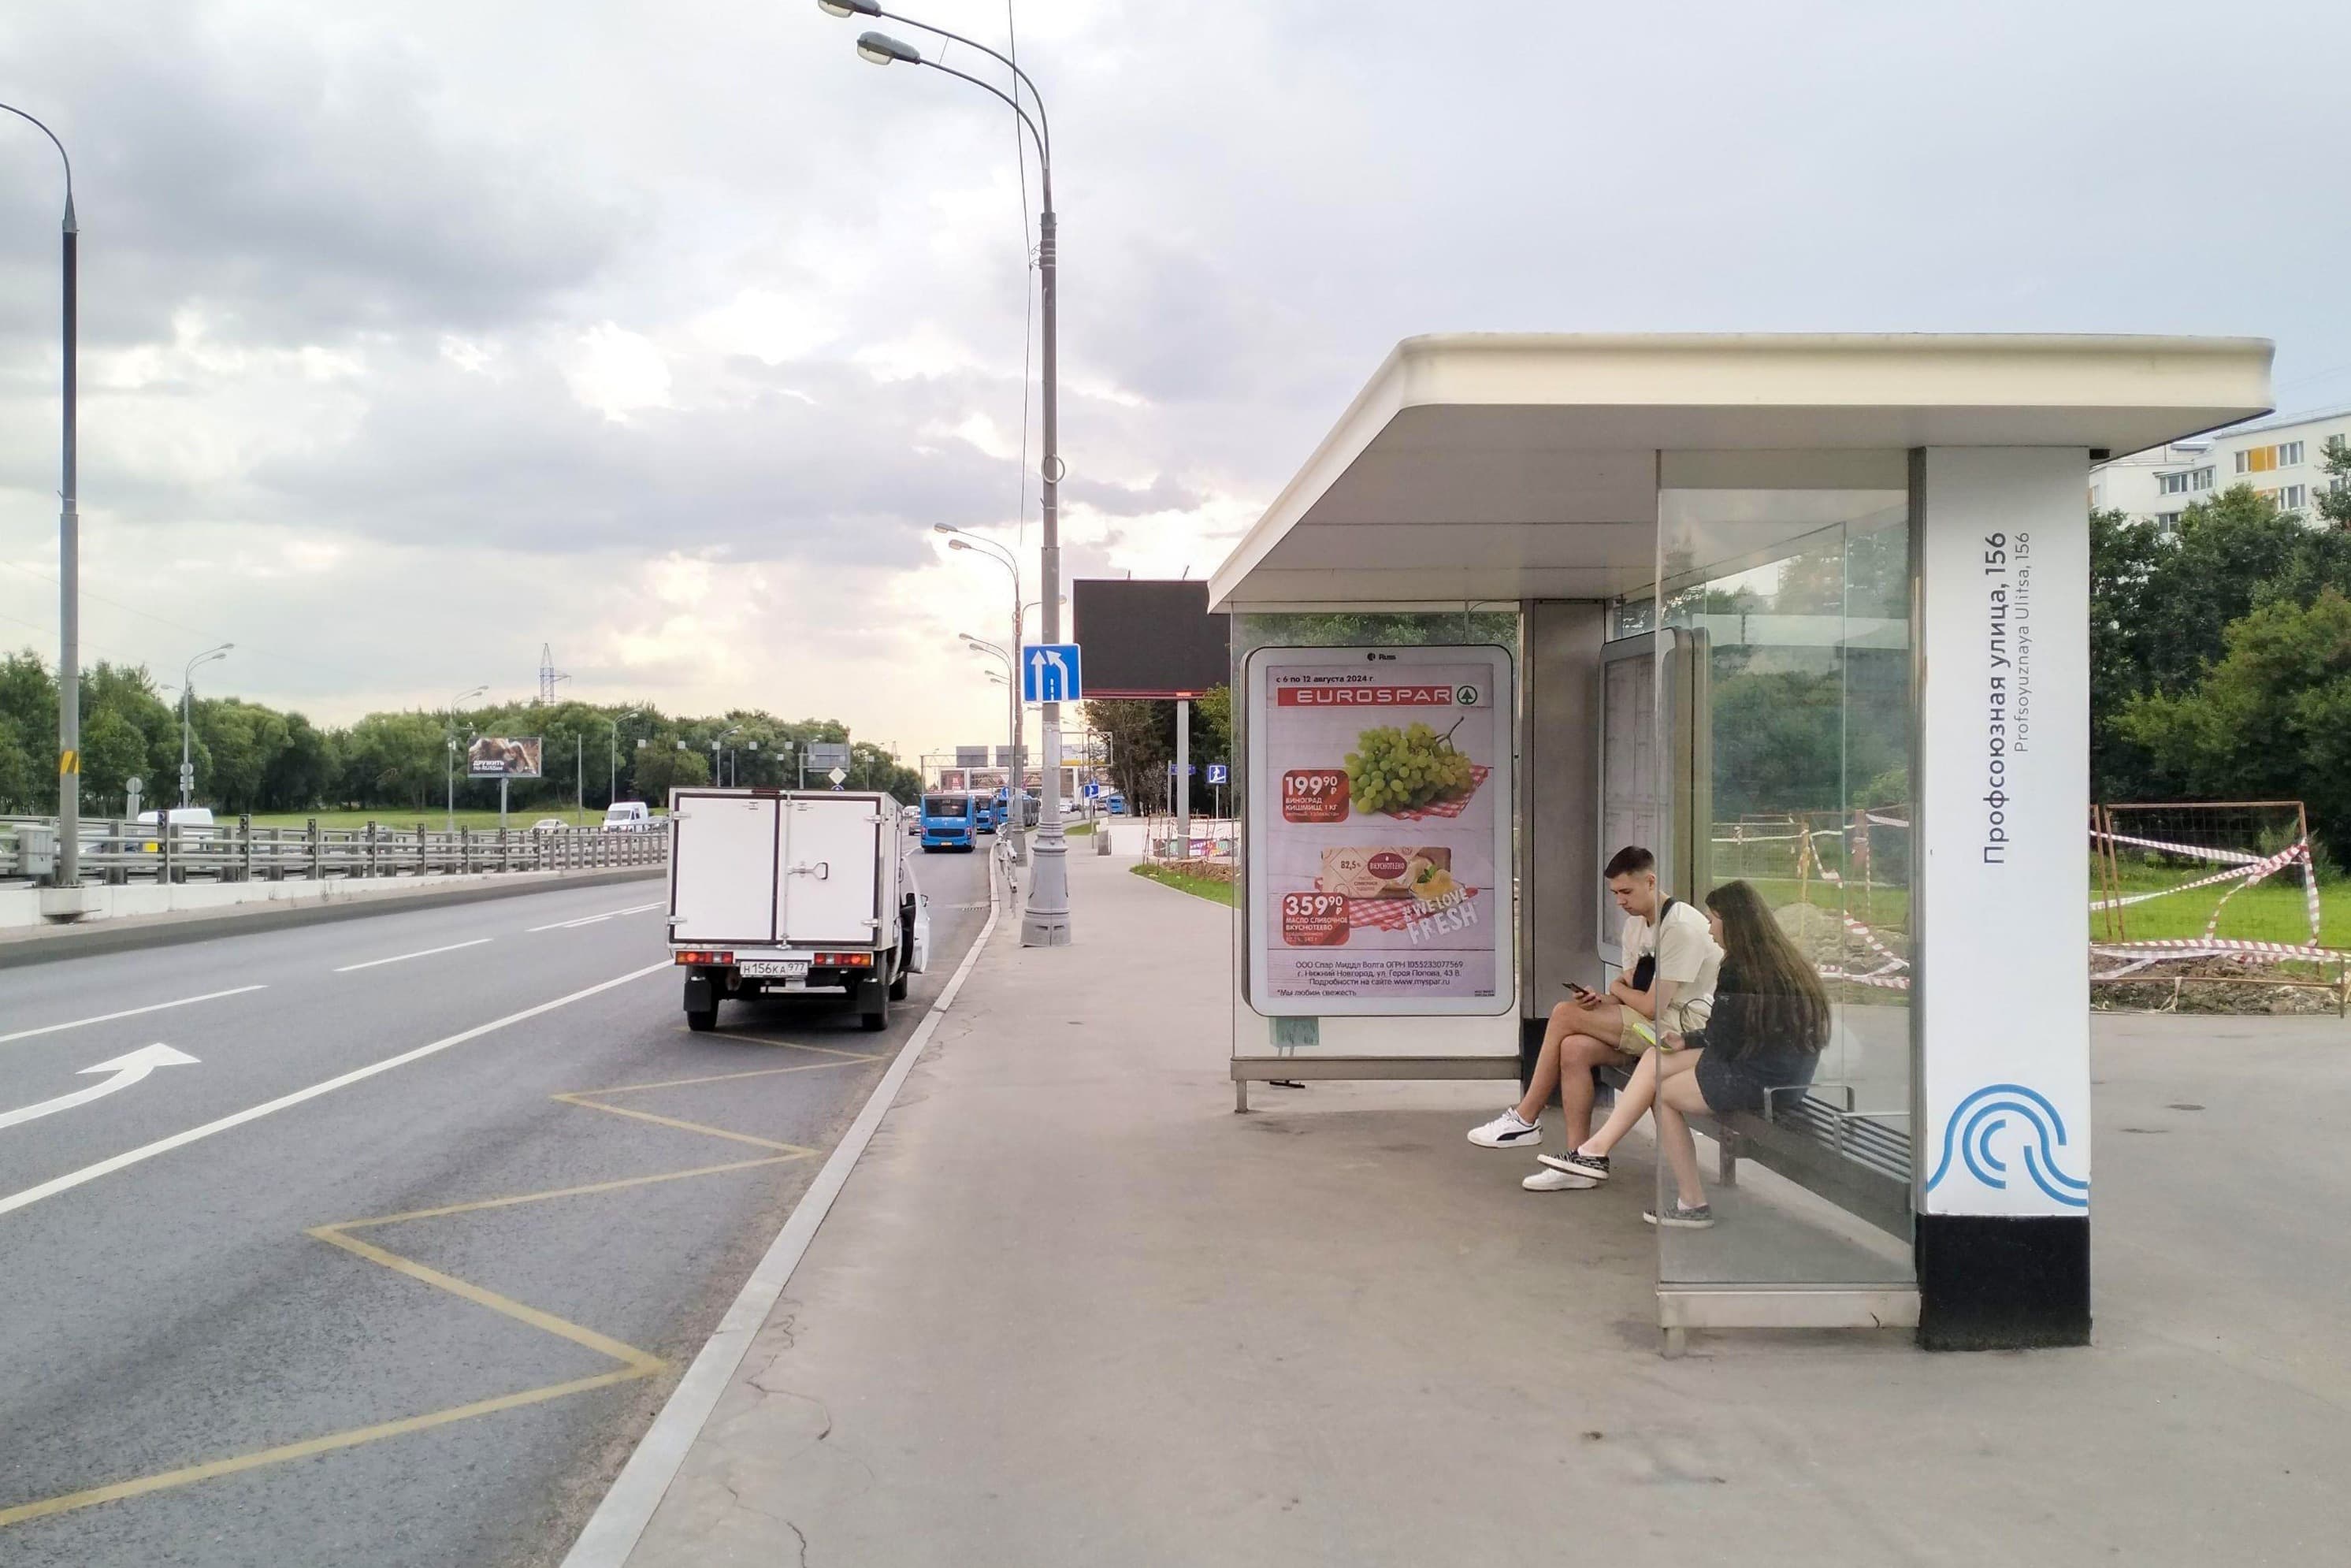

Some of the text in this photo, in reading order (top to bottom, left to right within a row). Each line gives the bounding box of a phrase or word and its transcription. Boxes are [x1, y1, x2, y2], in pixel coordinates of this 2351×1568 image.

[2014, 532, 2033, 752] Profsoyuznaya Ulitsa, 156
[1296, 689, 1450, 703] EUROSPAR
[1983, 532, 2011, 865] Профсоюзная улица, 156
[1285, 775, 1323, 796] 199
[1285, 895, 1328, 916] 359
[1435, 887, 1469, 909] LOVE
[1314, 960, 1334, 970] Спар
[1335, 960, 1361, 969] Миддл
